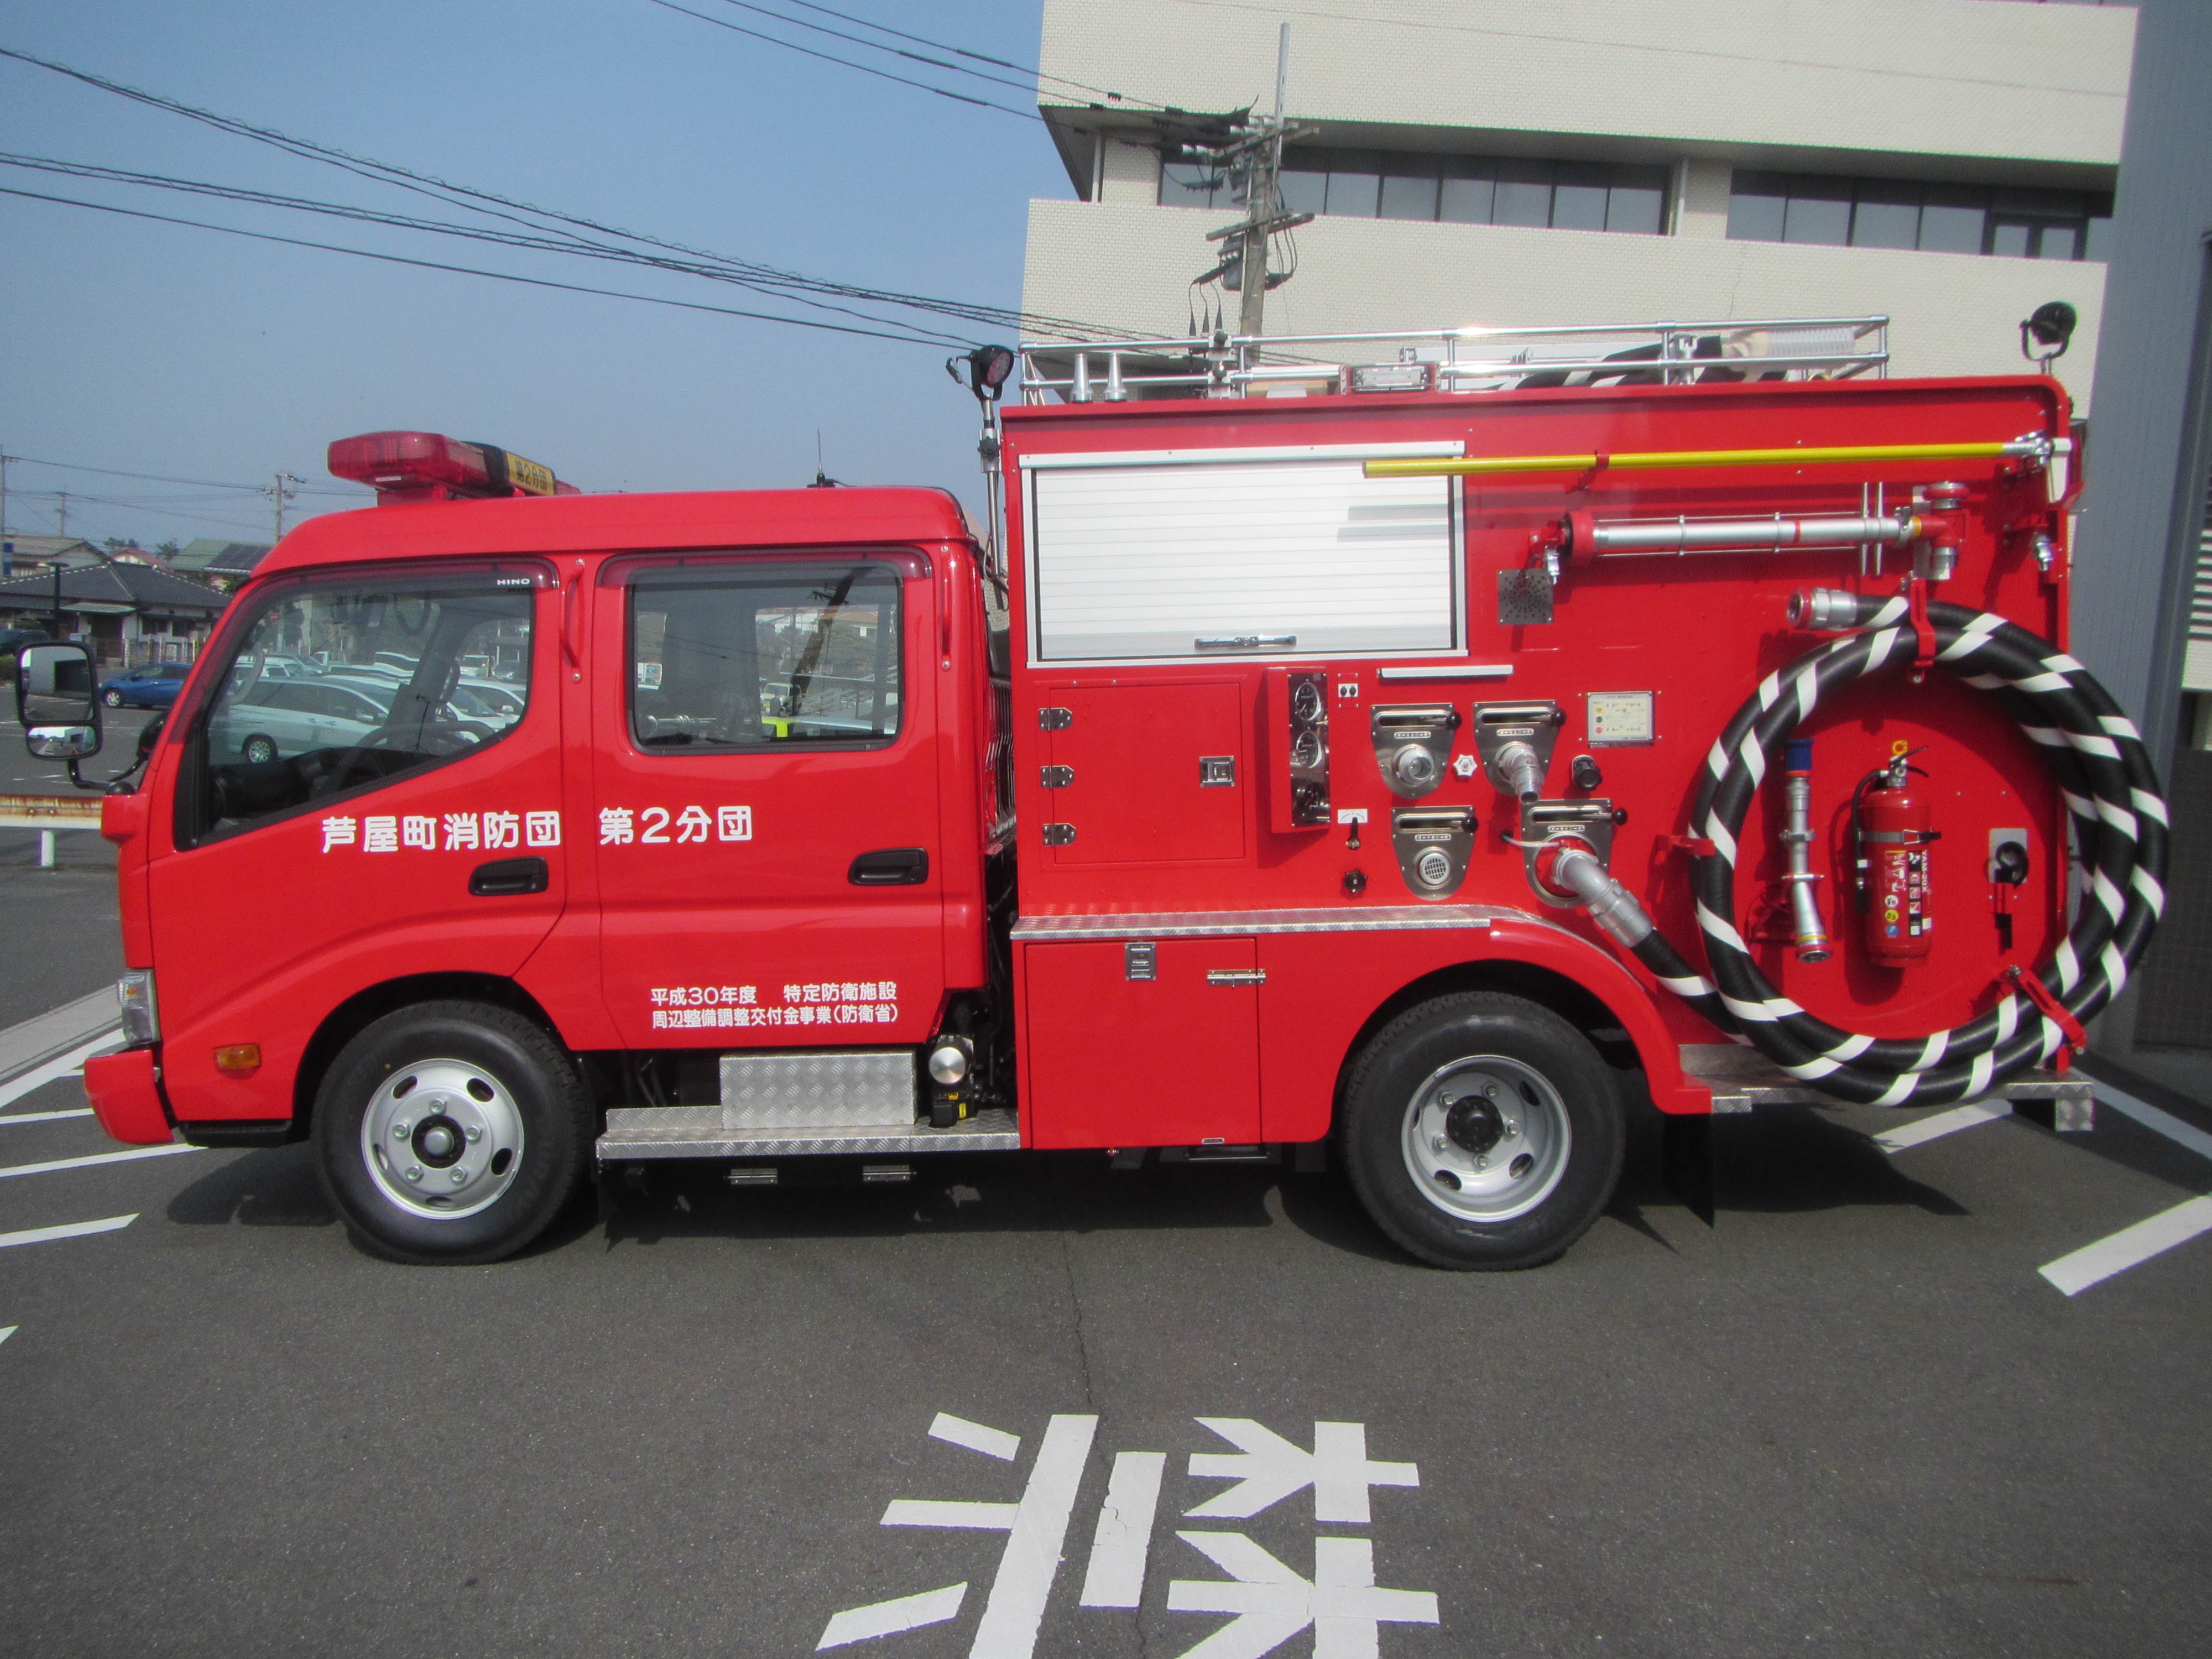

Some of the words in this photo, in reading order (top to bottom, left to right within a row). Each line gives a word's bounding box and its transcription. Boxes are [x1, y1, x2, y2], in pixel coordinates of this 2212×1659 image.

[322, 811, 560, 853] 芦屋町消防団
[599, 806, 752, 845] 第2分団
[651, 985, 757, 1006] 平成30年度
[783, 982, 897, 1003] 特定防衛施設
